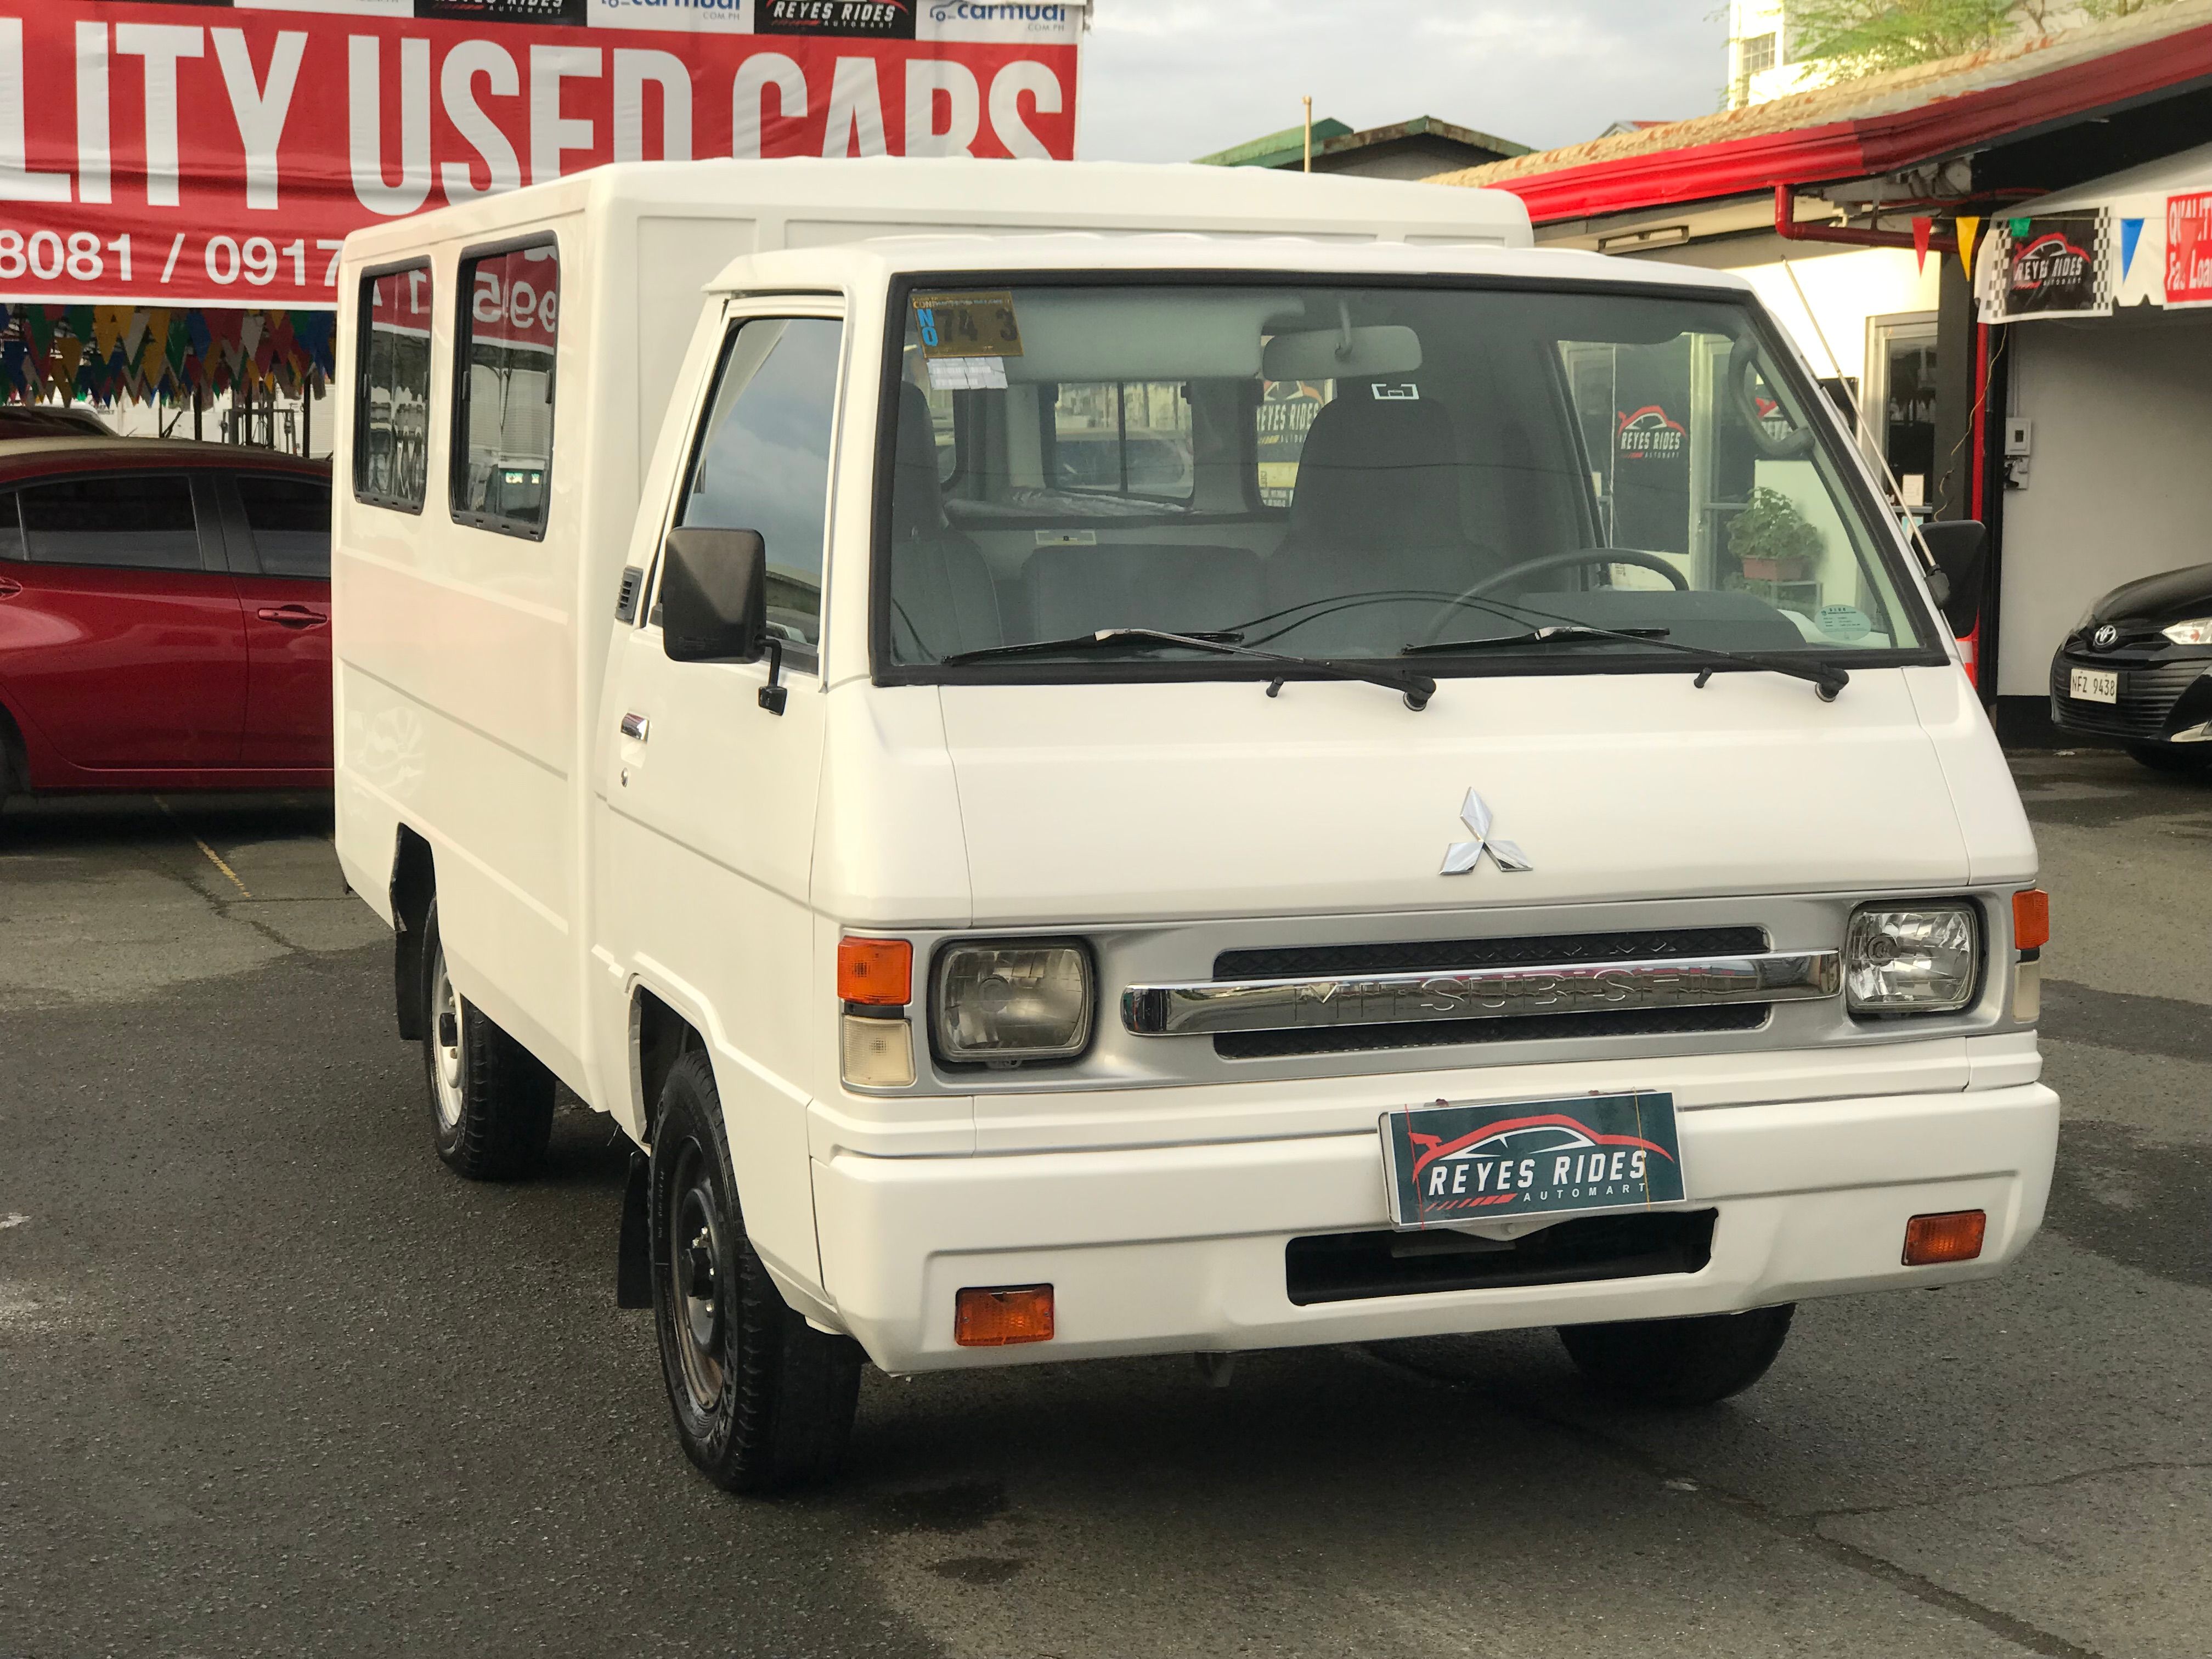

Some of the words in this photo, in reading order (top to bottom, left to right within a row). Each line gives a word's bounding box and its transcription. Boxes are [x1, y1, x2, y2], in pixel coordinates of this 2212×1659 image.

[774, 1, 833, 19] REYES
[842, 3, 895, 21] RIDES
[958, 4, 1065, 21] carmudi
[825, 20, 892, 29] AUTOMART
[348, 35, 692, 215] USED
[0, 229, 132, 281] 8081
[205, 235, 344, 287] 0917
[2014, 259, 2049, 281] REYES
[2052, 256, 2083, 277] RIDES
[2189, 249, 2212, 289] Loa
[1621, 431, 1650, 450] REYES
[1653, 431, 1681, 450] RIDES
[2072, 675, 2087, 693] NFZ
[2093, 678, 2115, 696] 9438
[1429, 1161, 1536, 1197] REYES
[1553, 1150, 1647, 1186] RIDES
[1523, 1182, 1646, 1202] AUTOMART
